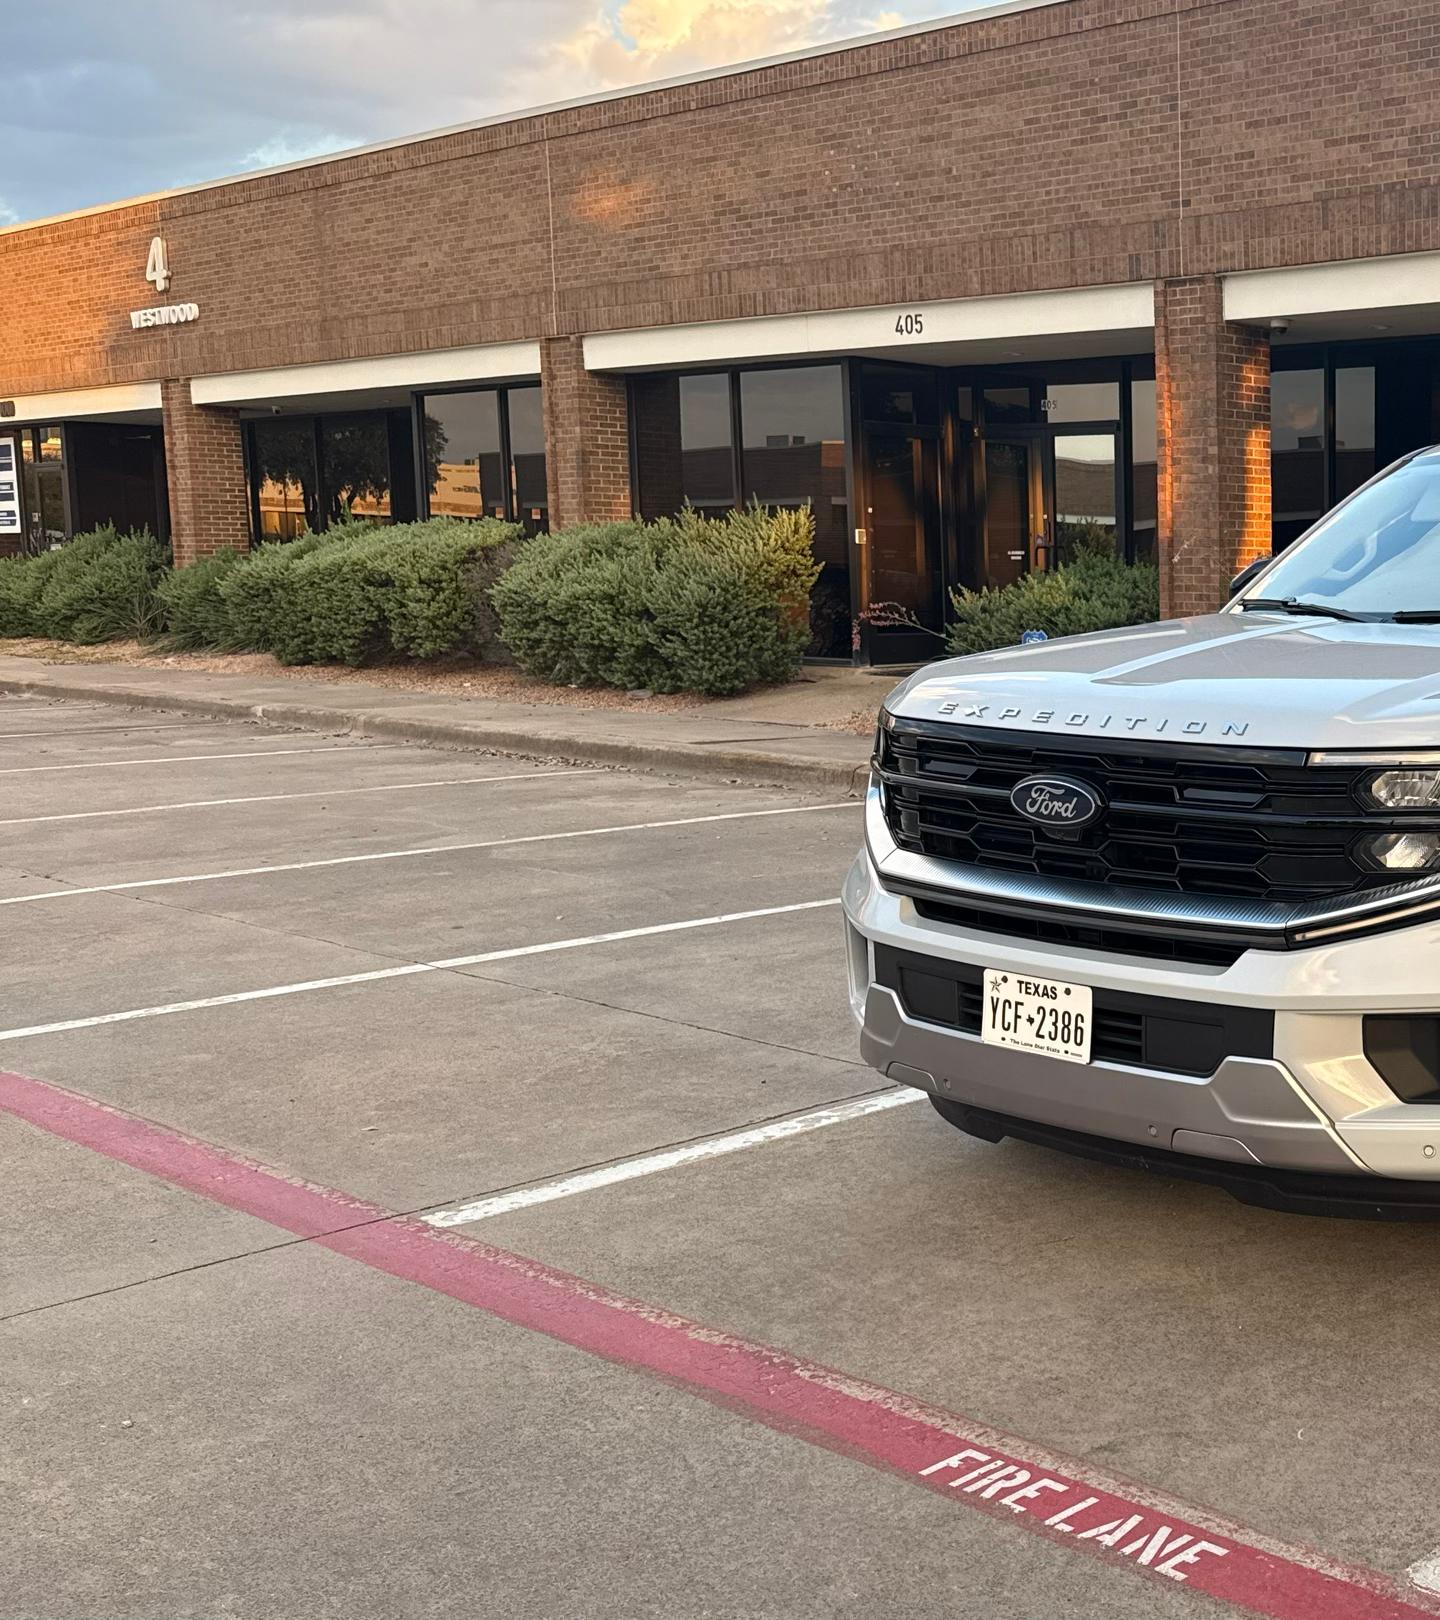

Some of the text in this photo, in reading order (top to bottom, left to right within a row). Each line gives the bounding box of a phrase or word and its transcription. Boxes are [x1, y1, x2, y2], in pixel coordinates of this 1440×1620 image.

[146, 236, 171, 292] 4
[130, 303, 199, 329] WESTWOOD
[895, 314, 923, 335] 405
[937, 701, 1249, 736] EXPEDITION
[1026, 784, 1079, 818] Ford
[1016, 979, 1058, 1001] TEXAS
[918, 1448, 1231, 1582] FIRE LANE
